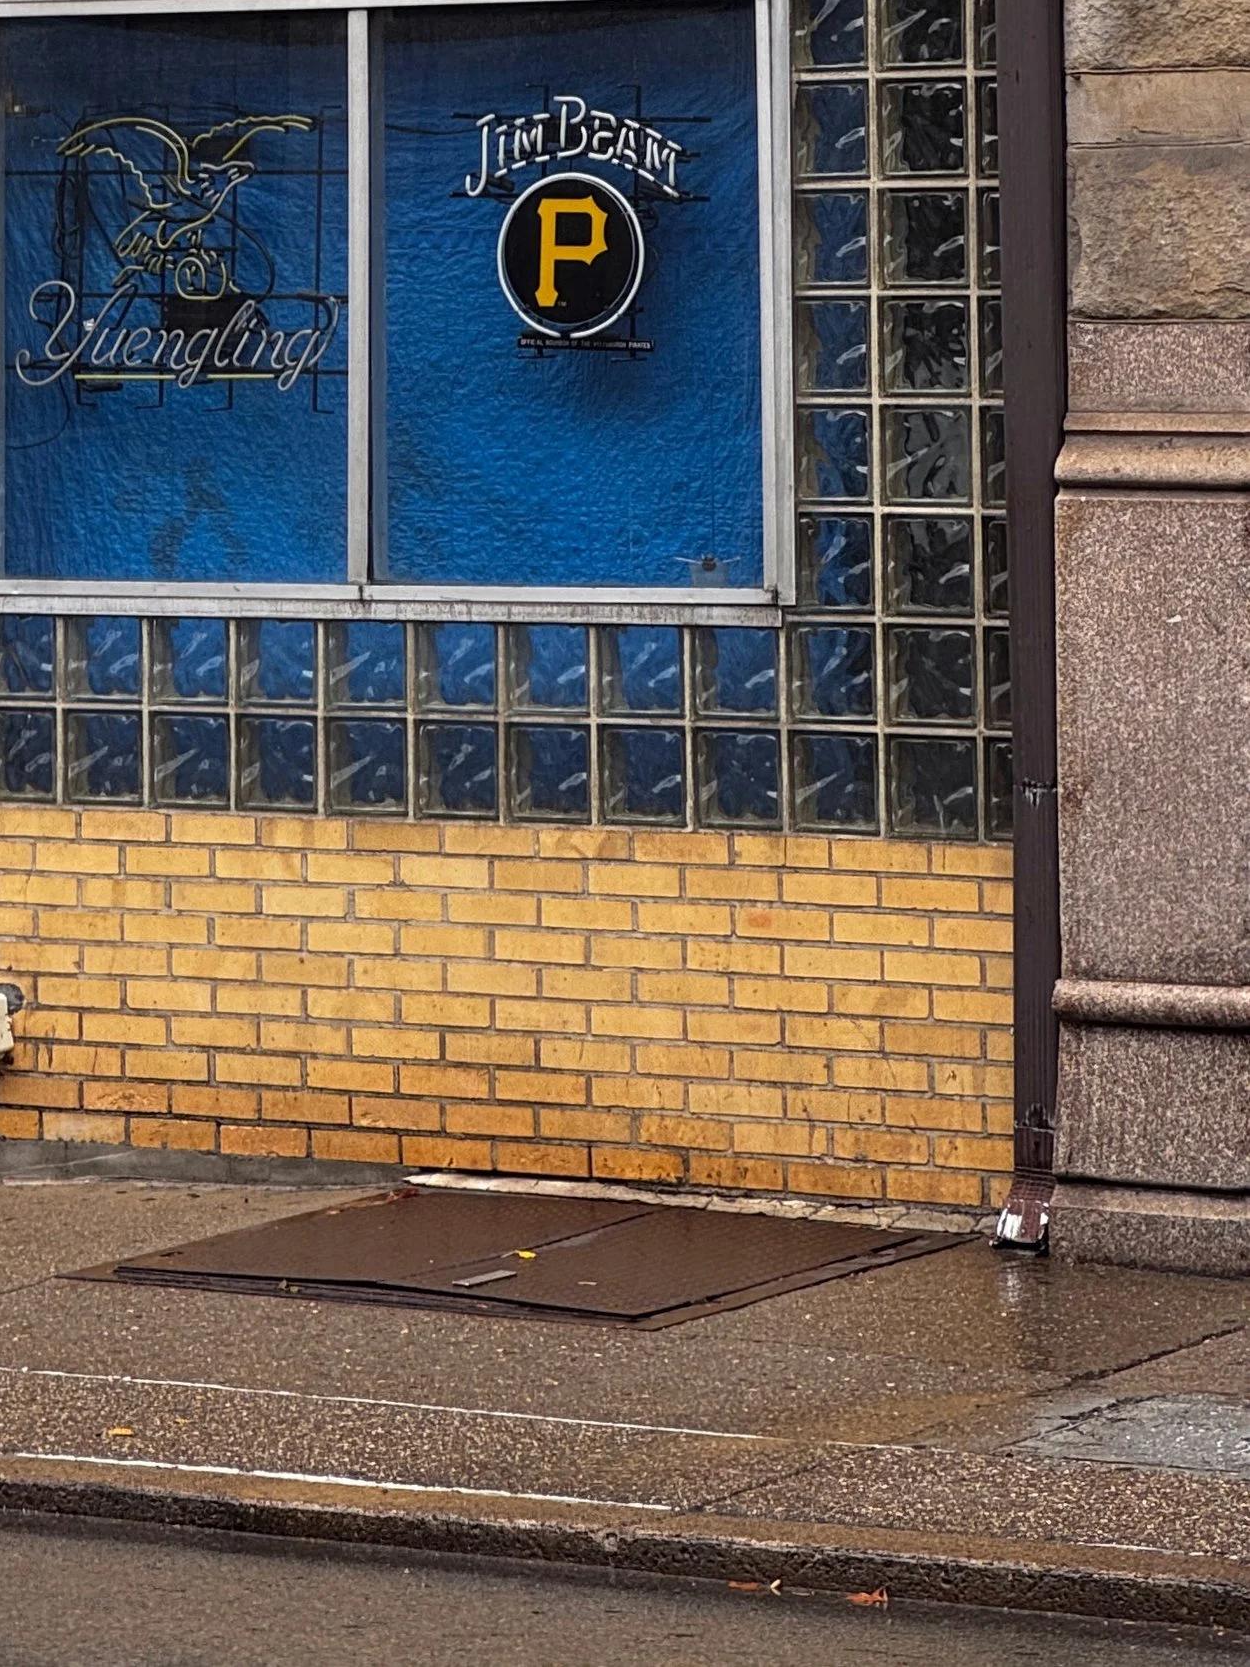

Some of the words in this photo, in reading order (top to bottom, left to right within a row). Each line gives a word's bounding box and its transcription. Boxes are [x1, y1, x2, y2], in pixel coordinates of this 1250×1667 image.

[465, 114, 551, 197] JIM
[553, 95, 683, 198] BEAM
[534, 194, 609, 308] P
[15, 280, 340, 391] Yuengling
